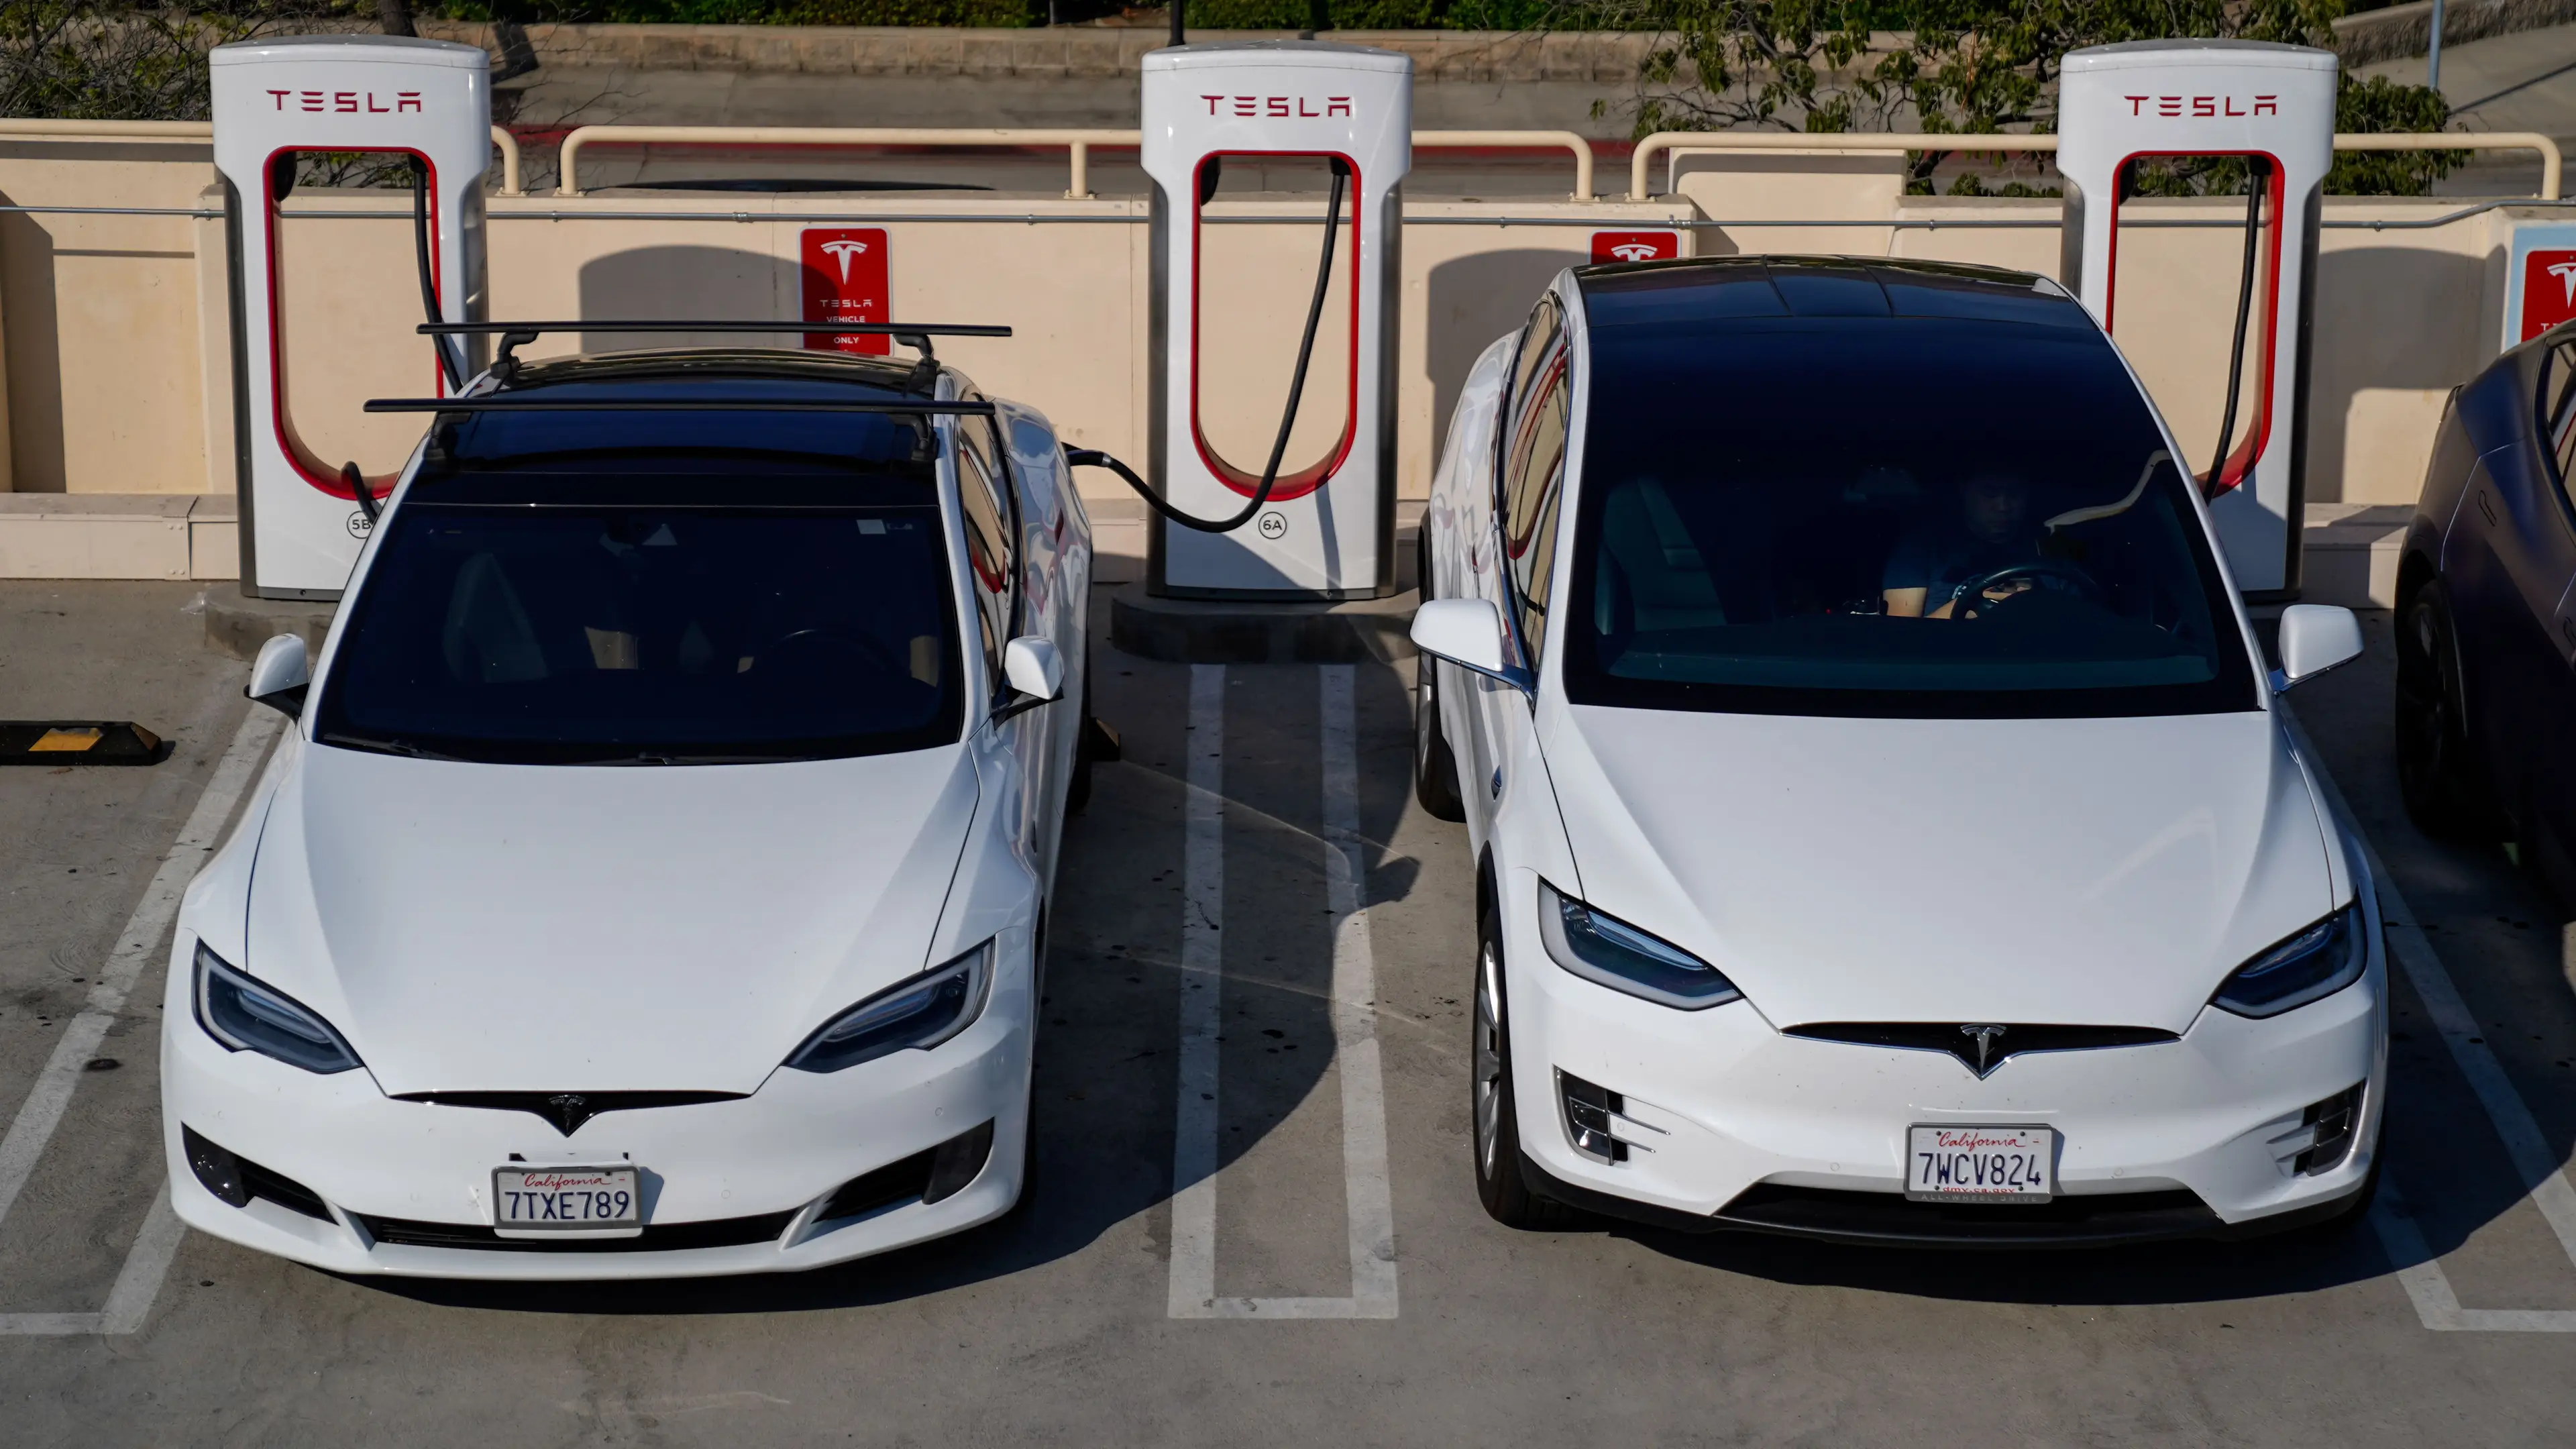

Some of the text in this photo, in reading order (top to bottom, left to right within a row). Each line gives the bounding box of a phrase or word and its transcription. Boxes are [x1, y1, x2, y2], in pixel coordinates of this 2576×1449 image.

[266, 89, 421, 113] TESLA
[1199, 95, 1350, 117] TESLA
[2124, 95, 2277, 116] TESLA
[819, 299, 873, 308] TESLA
[352, 519, 372, 530] 5B
[1263, 520, 1283, 531] 6A
[1939, 1131, 2025, 1151] California
[1918, 1152, 2041, 1186] 7WCV824
[524, 1174, 611, 1191] California
[504, 1191, 629, 1220] 7TXE789
